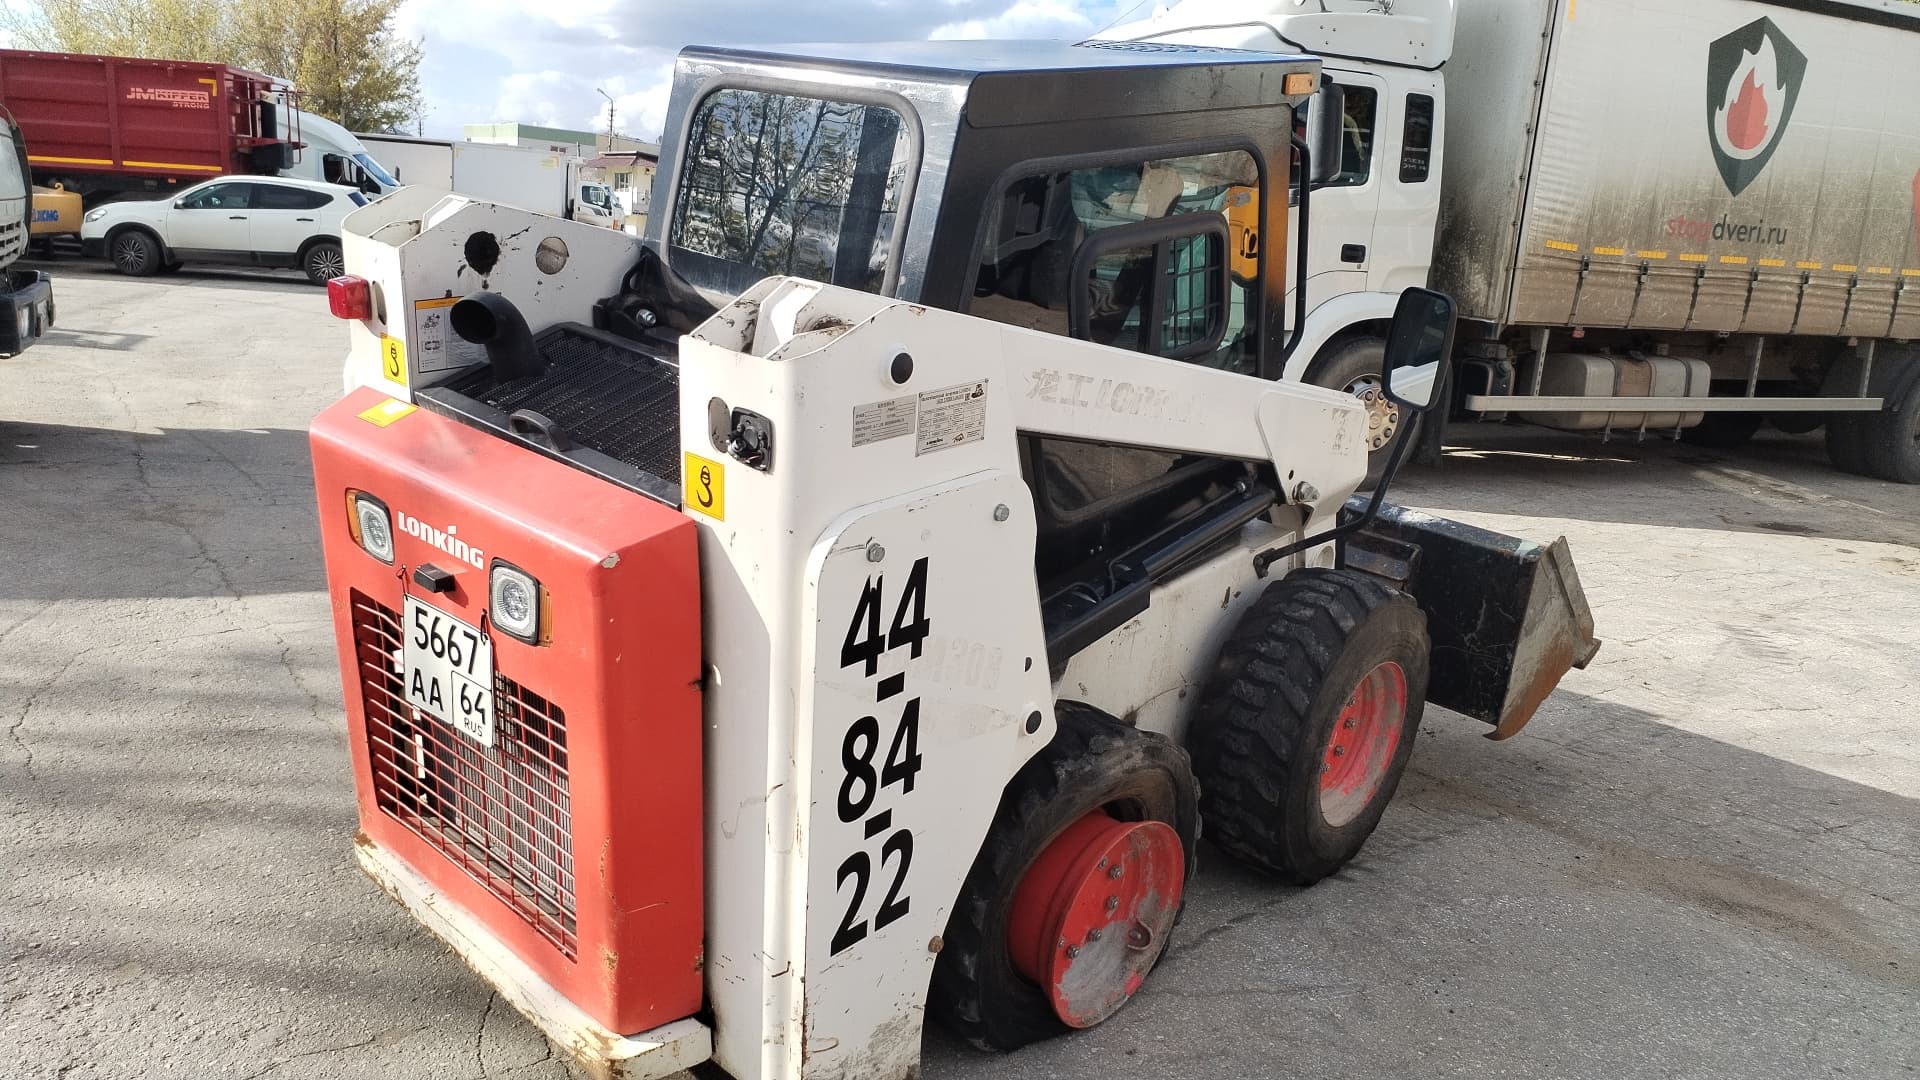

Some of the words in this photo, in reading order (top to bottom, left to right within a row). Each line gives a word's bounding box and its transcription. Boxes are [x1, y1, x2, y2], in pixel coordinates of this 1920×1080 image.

[172, 101, 210, 109] STRONG
[1665, 213, 1788, 245] stopdveri.ru
[414, 605, 478, 675] 5667
[840, 556, 930, 678] 44
[460, 682, 486, 725] 64
[464, 718, 483, 737] RUS
[837, 696, 923, 824] 84
[830, 828, 915, 958] 22
